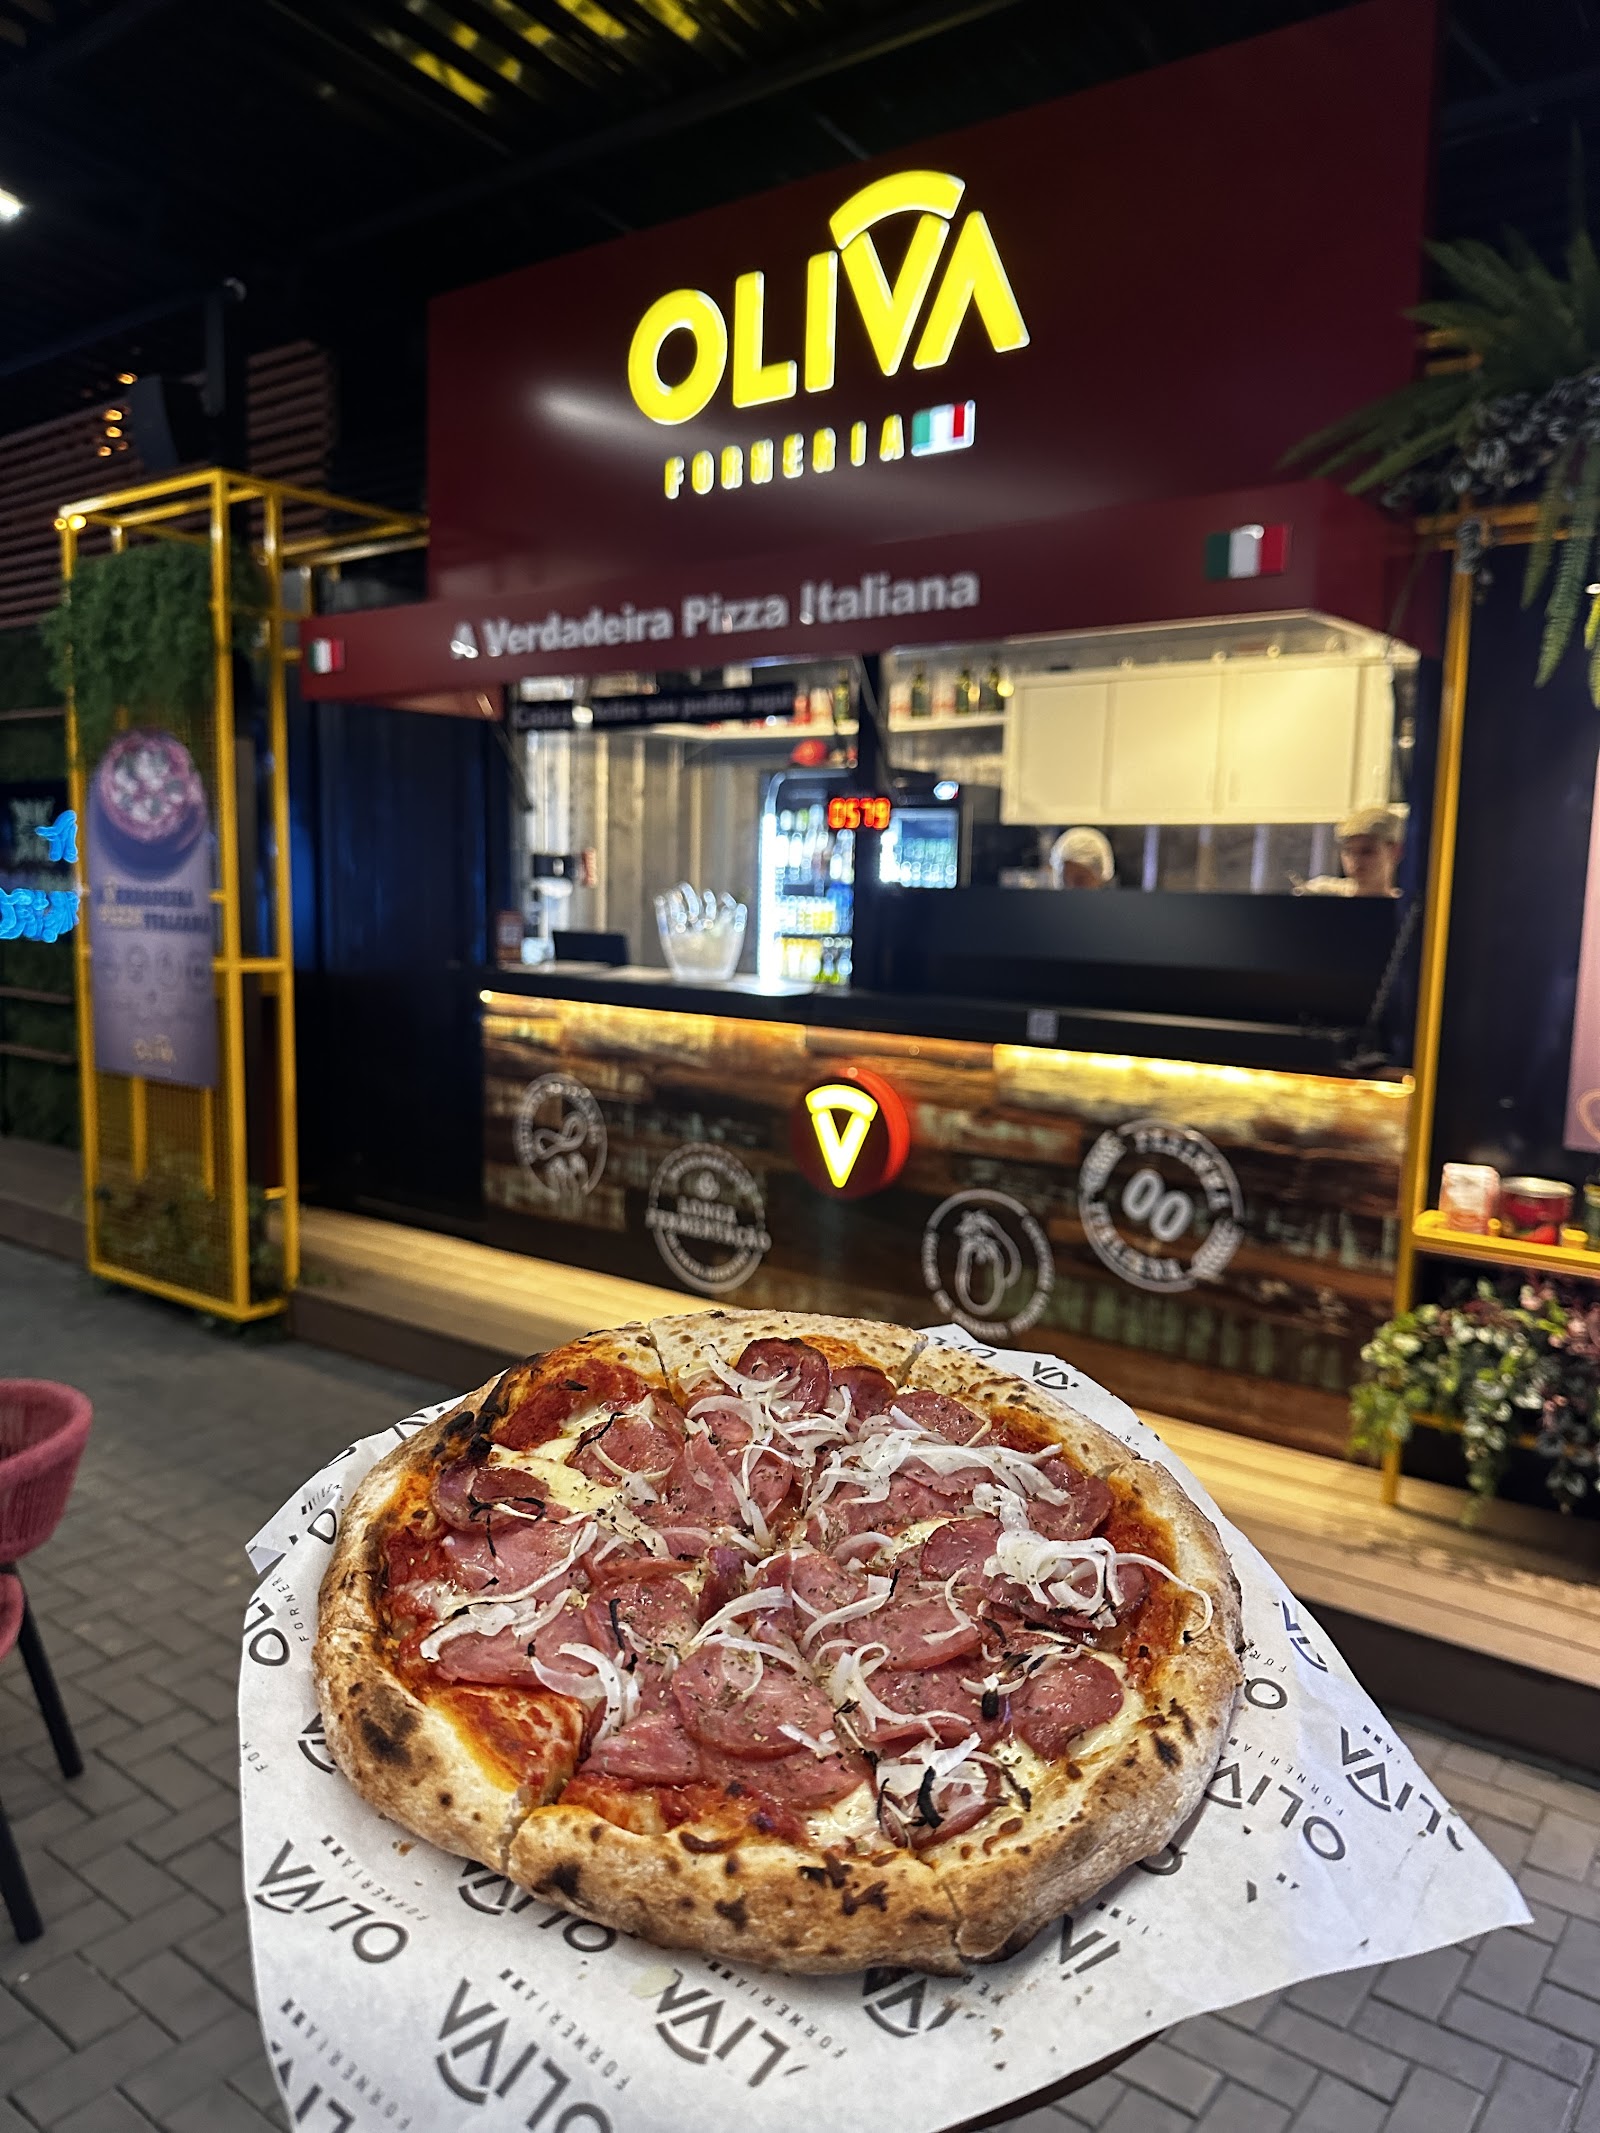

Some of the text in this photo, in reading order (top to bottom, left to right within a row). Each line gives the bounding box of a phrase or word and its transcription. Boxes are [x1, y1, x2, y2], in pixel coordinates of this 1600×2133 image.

[627, 170, 1031, 426] OLIVA
[664, 413, 905, 500] FORNERIA
[450, 570, 980, 658] A Verdadeira Pizza Italiana
[267, 1573, 310, 1642] FORNERI
[1203, 1753, 1346, 1860] OLIV
[1243, 1743, 1344, 1816] FORNERIA
[253, 1839, 410, 1965] OLIVA
[341, 1857, 430, 1922] FORNERIA
[524, 1989, 631, 2091] FORNERIA
[655, 1967, 809, 2088] LIVA
[735, 1978, 848, 2059] FORNERIA
[305, 2024, 413, 2131] FORNERIA
